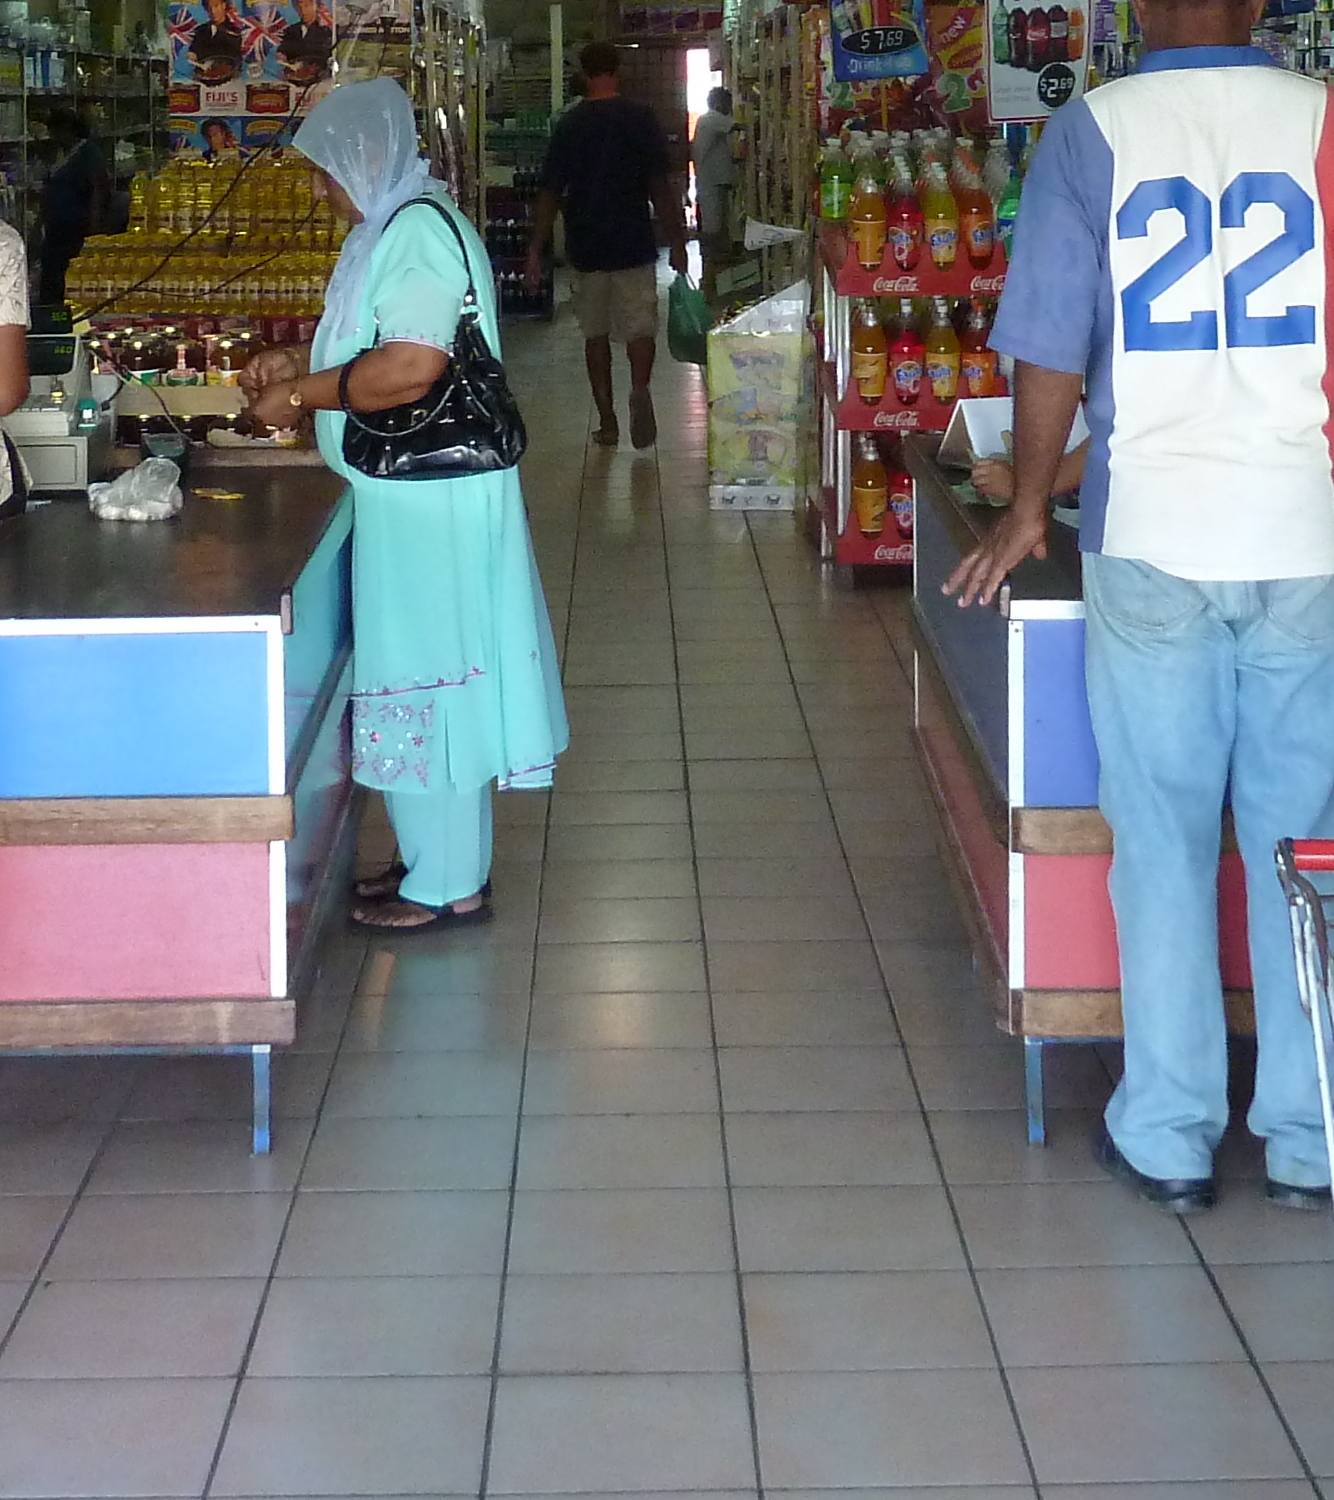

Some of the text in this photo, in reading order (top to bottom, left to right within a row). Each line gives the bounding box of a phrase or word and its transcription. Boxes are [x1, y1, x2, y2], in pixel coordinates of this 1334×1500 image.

[1116, 171, 1317, 355] 22
[873, 276, 917, 292] Coca-Cola
[874, 411, 917, 427] Coca-Cola
